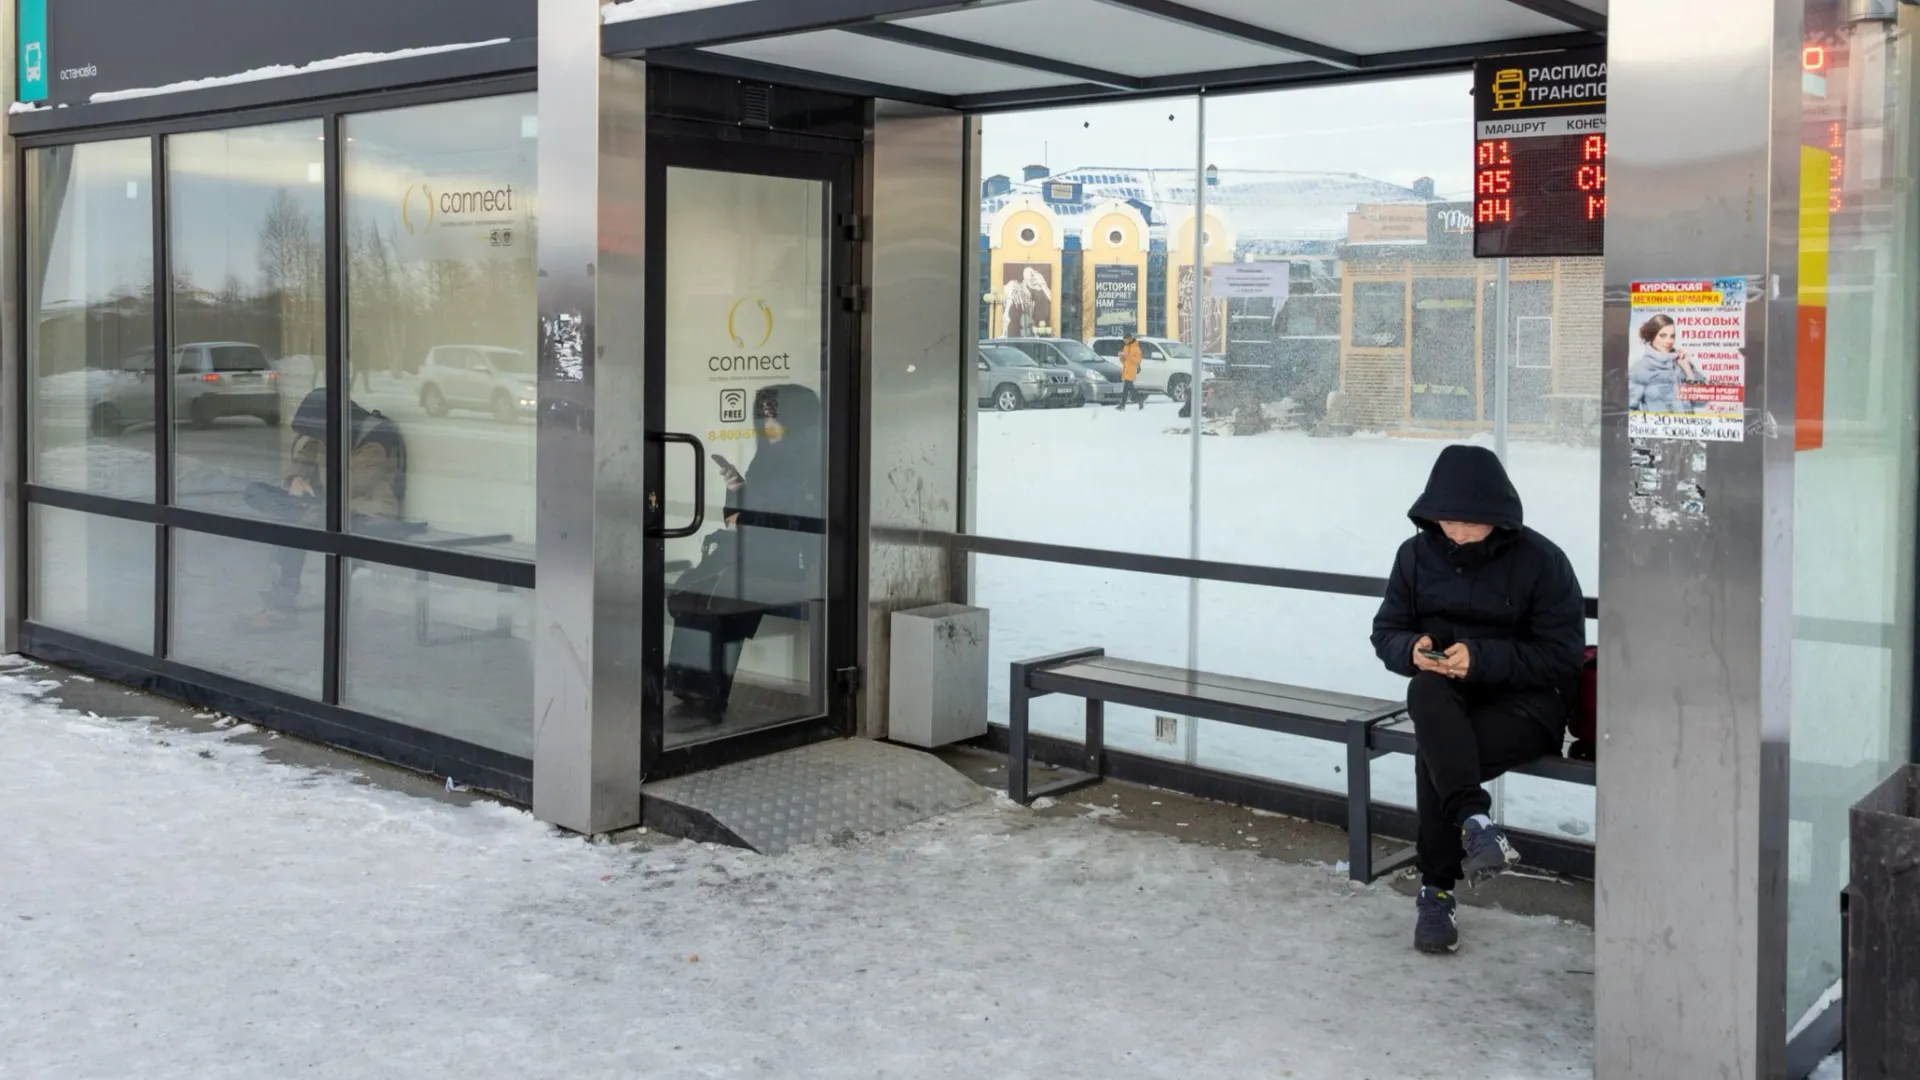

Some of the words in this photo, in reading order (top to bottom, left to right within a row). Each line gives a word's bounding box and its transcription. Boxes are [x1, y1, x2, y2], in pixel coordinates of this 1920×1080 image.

[60, 63, 97, 81] остановка
[1485, 121, 1547, 135] МАРШРУТ
[1478, 141, 1511, 165] А1
[1478, 170, 1511, 194] А5
[440, 184, 513, 214] connect
[1478, 198, 1511, 222] А4
[1096, 281, 1137, 292] ИСТОРИЯ
[1639, 282, 1703, 293] КИРОВСКАЯ
[1097, 291, 1132, 299] ДОВЕРЯЕТ
[1633, 294, 1675, 305] МЕХОВАЯ
[1676, 293, 1720, 304] ЯРМАРКА
[1096, 299, 1114, 308] НАМ
[1677, 316, 1741, 326] МЕХОВЫХ
[1111, 325, 1124, 335] US
[1697, 352, 1740, 360] КОЖАНЫЕ
[708, 353, 791, 371] connect
[1701, 363, 1740, 372] ИЗДЕЛИЯ
[723, 409, 743, 419] FREE
